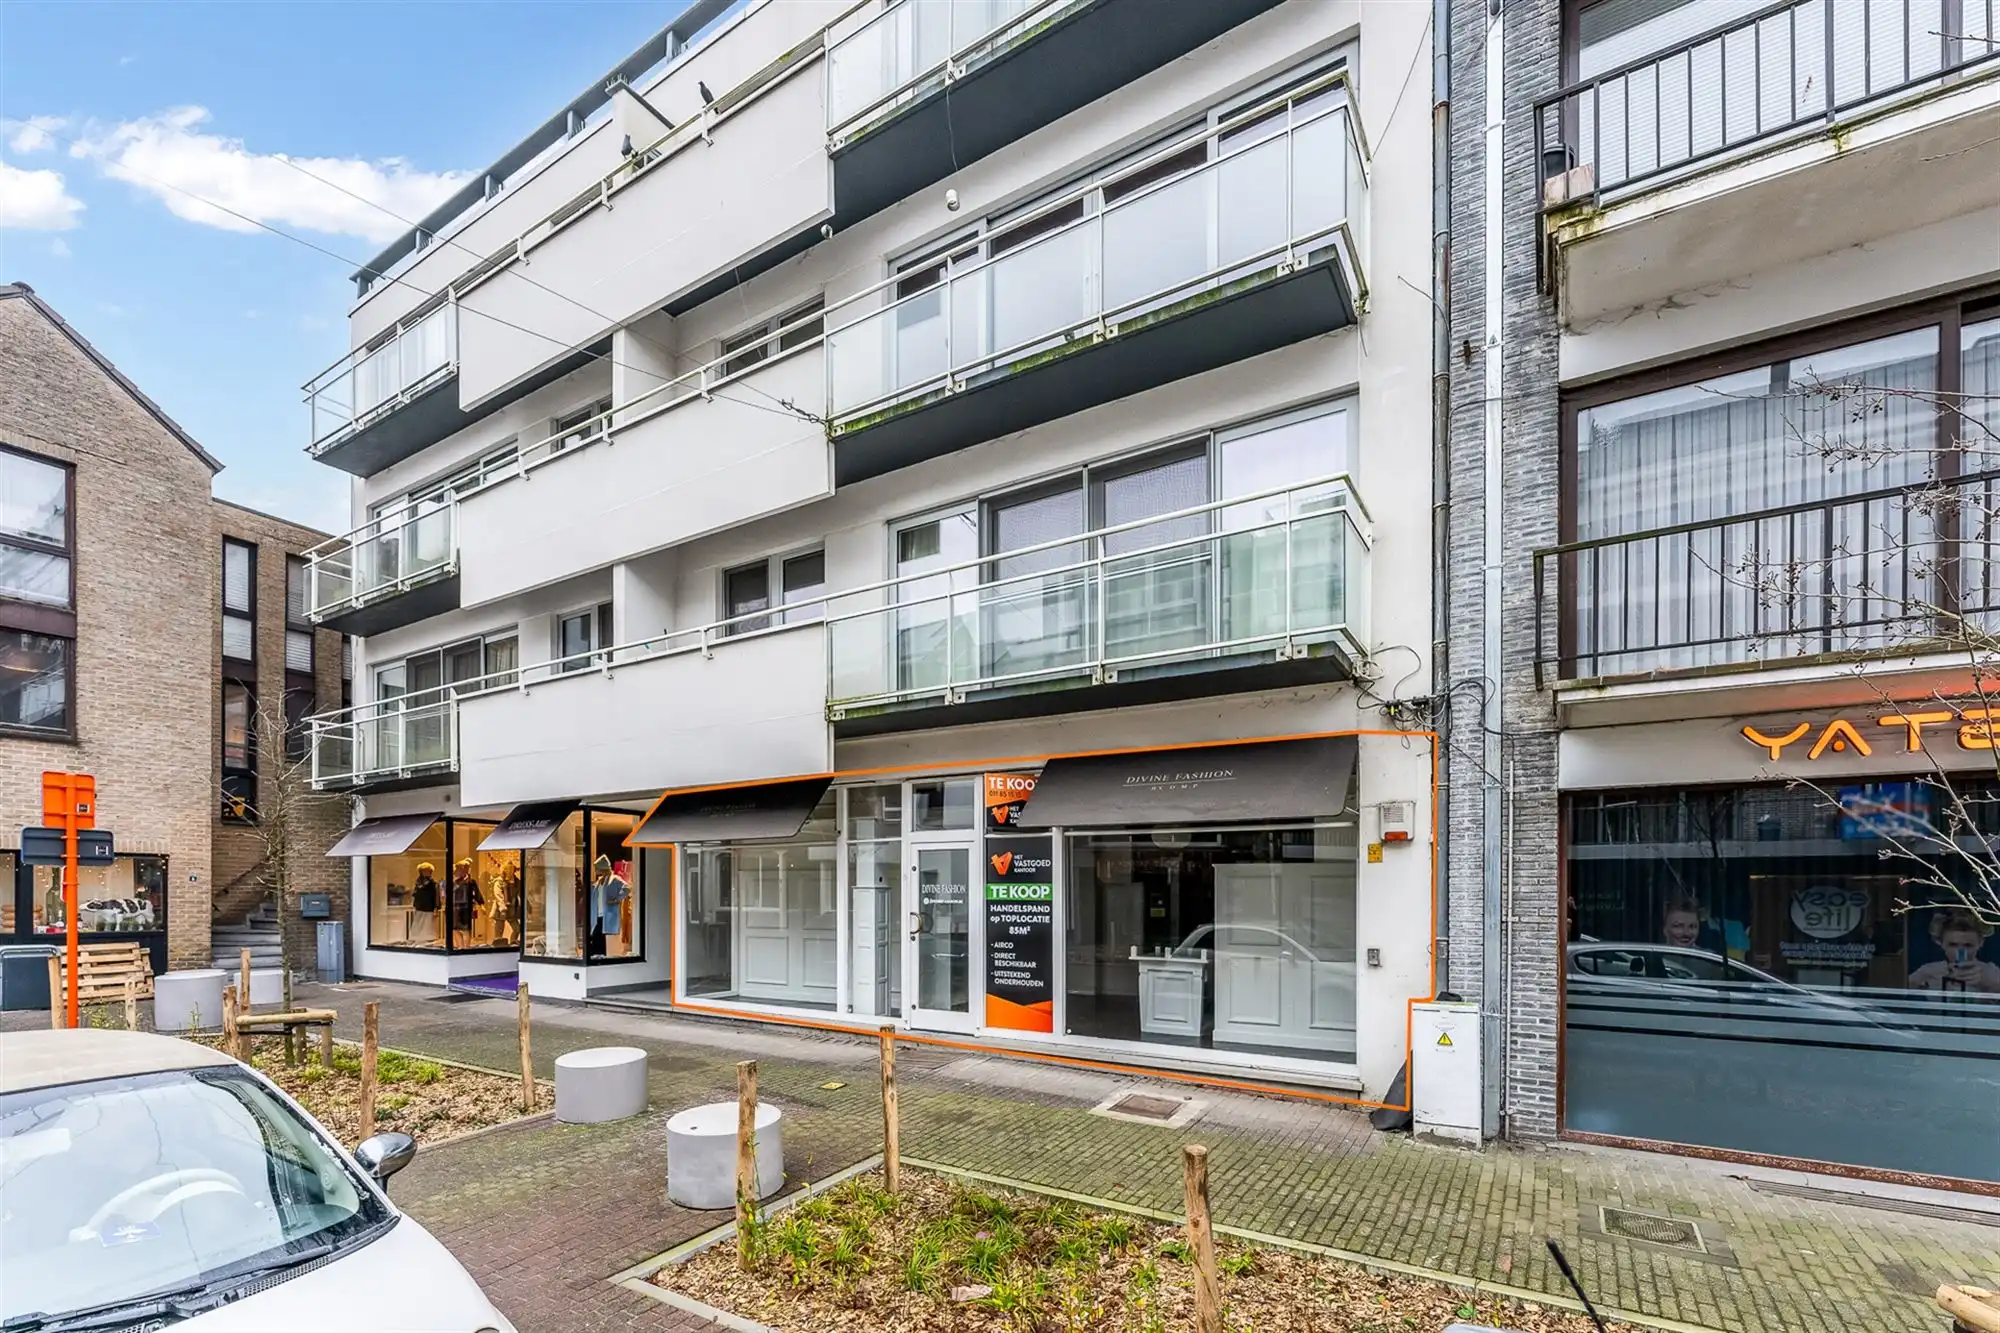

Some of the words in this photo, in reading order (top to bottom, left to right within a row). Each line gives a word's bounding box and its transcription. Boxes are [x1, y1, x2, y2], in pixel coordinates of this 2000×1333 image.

[1126, 774, 1170, 784] DIVINE
[1175, 769, 1234, 780] FASHION
[989, 776, 1004, 789] TE
[1006, 778, 1038, 791] KOO
[1013, 859, 1052, 868] VASTGOED
[990, 885, 1008, 898] TE
[1009, 885, 1050, 899] KOOP
[990, 904, 1051, 913] HANDELSPAND
[990, 915, 1000, 924] op
[1001, 914, 1051, 923] TOPLOCATIE
[994, 959, 1037, 968] BESCHIKBAAR
[994, 978, 1044, 987] ONDERHOUDEN
